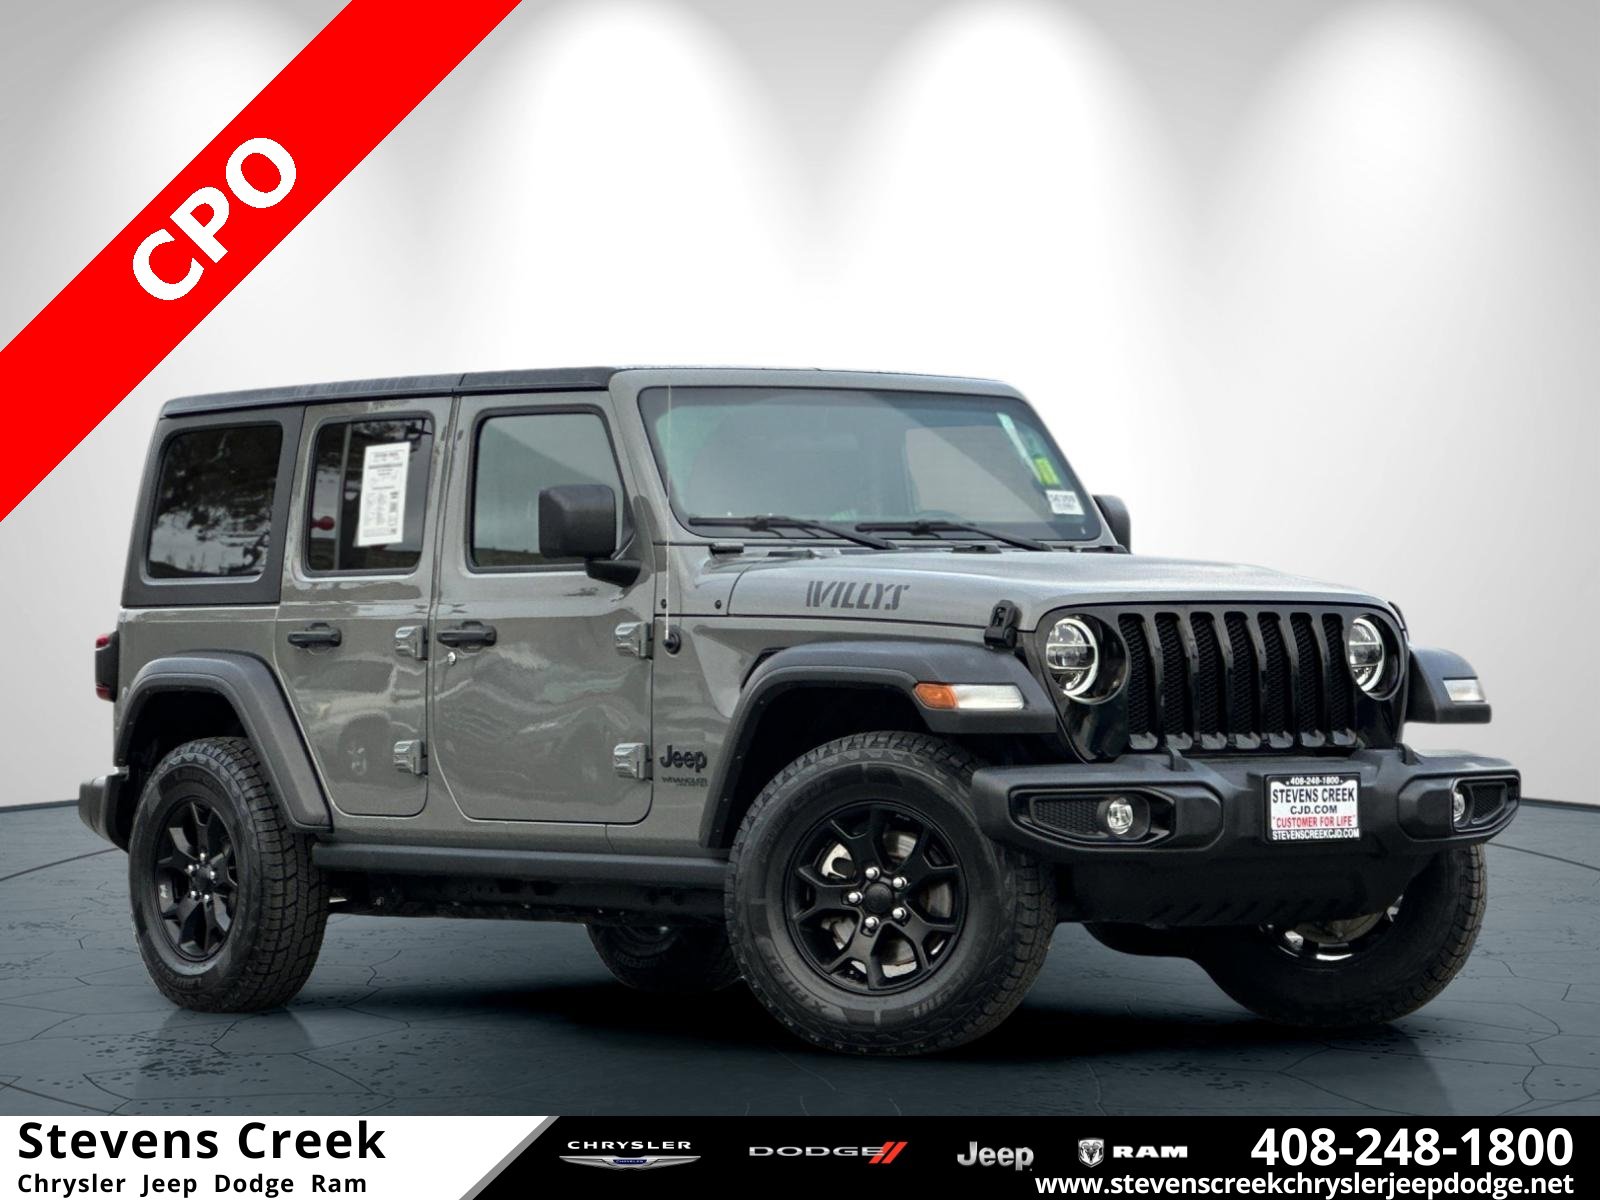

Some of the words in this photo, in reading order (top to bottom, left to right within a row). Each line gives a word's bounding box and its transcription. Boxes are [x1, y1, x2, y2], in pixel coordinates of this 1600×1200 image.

[806, 581, 910, 610] WILLYS
[659, 745, 707, 773] Jeep
[1272, 788, 1319, 803] STEVENS
[1322, 787, 1355, 802] CREEK
[1290, 805, 1338, 815] CJD.COM
[1320, 816, 1335, 827] FOR
